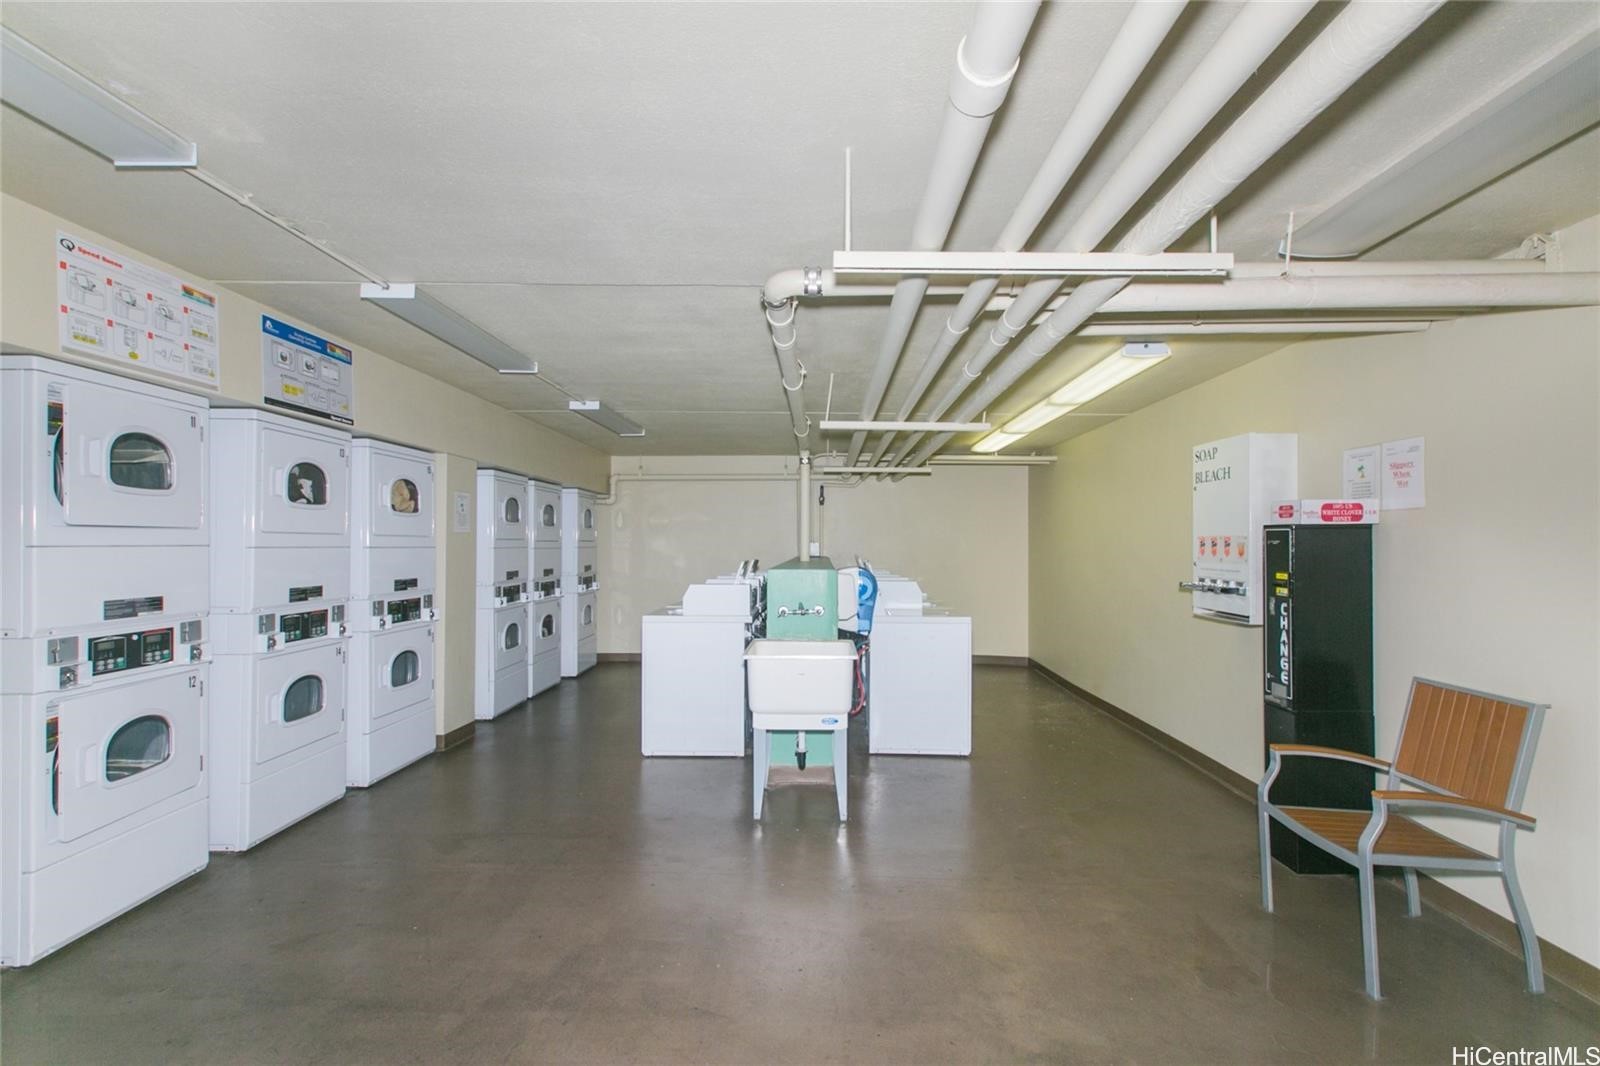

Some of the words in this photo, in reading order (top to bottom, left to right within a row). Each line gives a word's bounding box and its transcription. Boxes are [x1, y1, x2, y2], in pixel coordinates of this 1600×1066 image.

[1195, 447, 1218, 464] SOAP
[1195, 466, 1231, 484] BLEACH
[1280, 602, 1289, 686] CHANGE
[188, 675, 197, 689] 12
